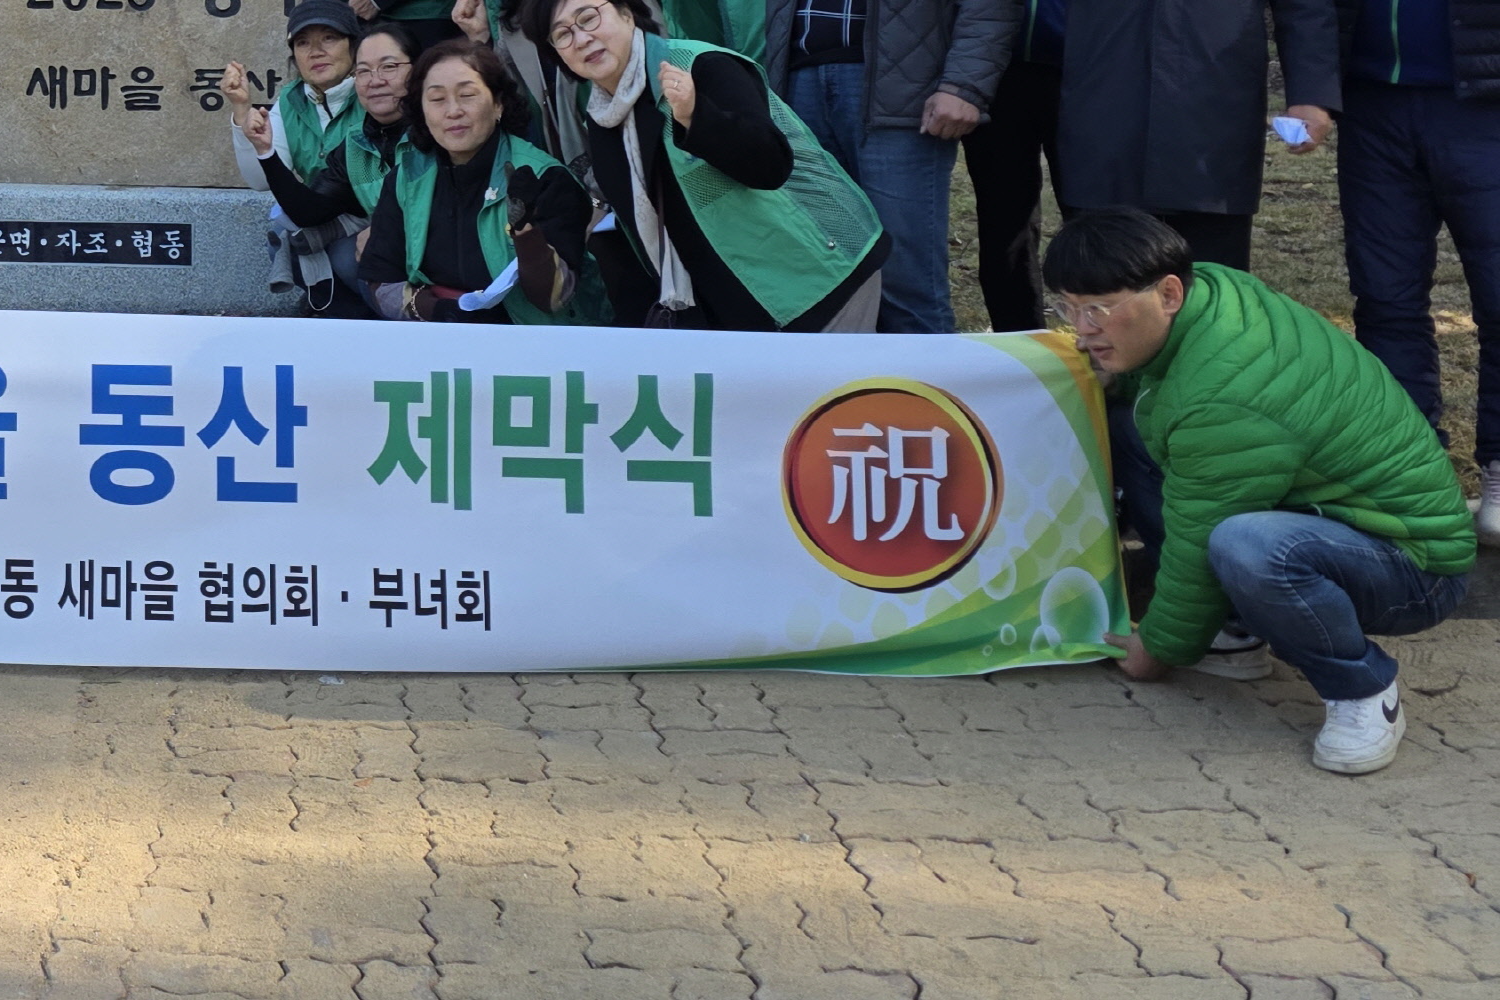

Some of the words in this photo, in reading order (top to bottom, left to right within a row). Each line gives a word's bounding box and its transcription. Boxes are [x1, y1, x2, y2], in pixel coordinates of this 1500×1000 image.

[26, 65, 164, 112] 새마을
[79, 364, 308, 506] 동산
[367, 369, 714, 517] 제막식
[827, 423, 965, 543] 祝
[57, 559, 179, 622] 새마을
[198, 561, 319, 627] 협의회
[369, 567, 491, 632] 부녀회
